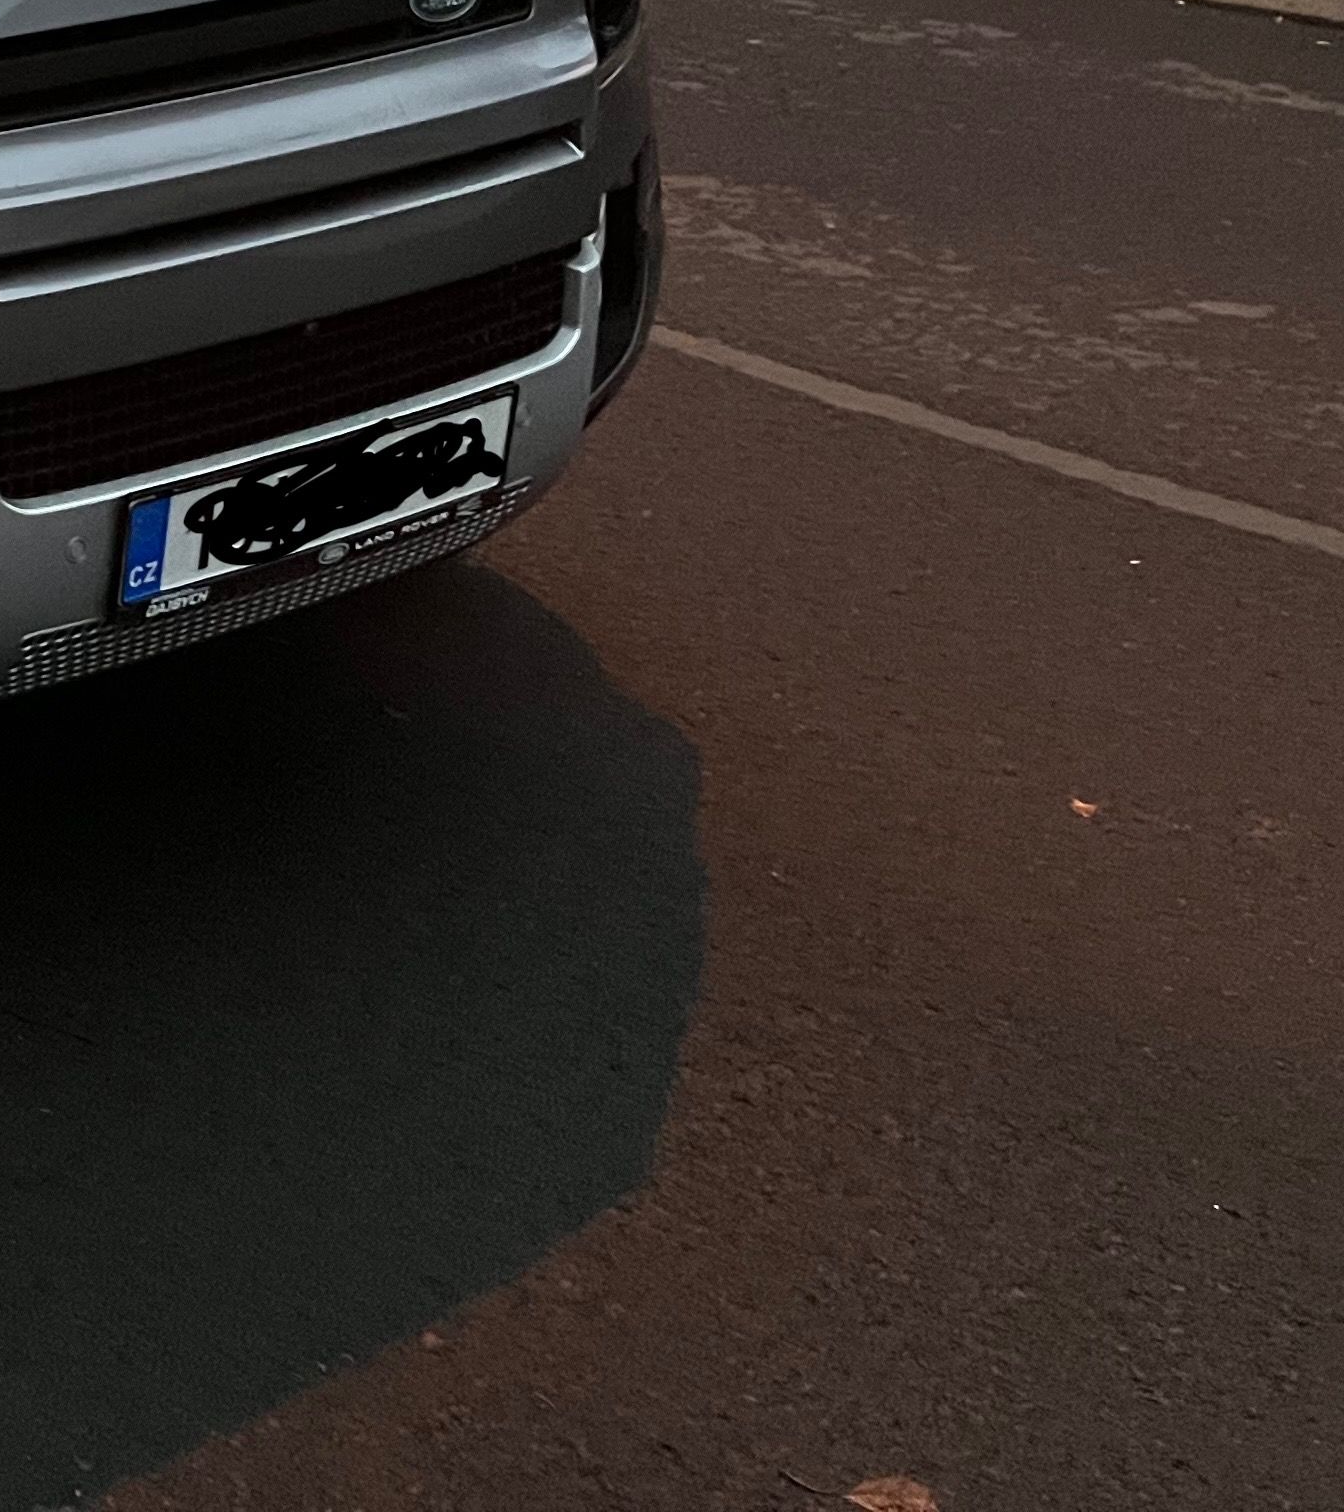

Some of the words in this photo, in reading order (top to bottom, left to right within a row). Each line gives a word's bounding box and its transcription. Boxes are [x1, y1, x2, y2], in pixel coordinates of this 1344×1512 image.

[355, 530, 395, 551] LAND
[401, 511, 450, 533] ROVER
[128, 560, 158, 588] CZ
